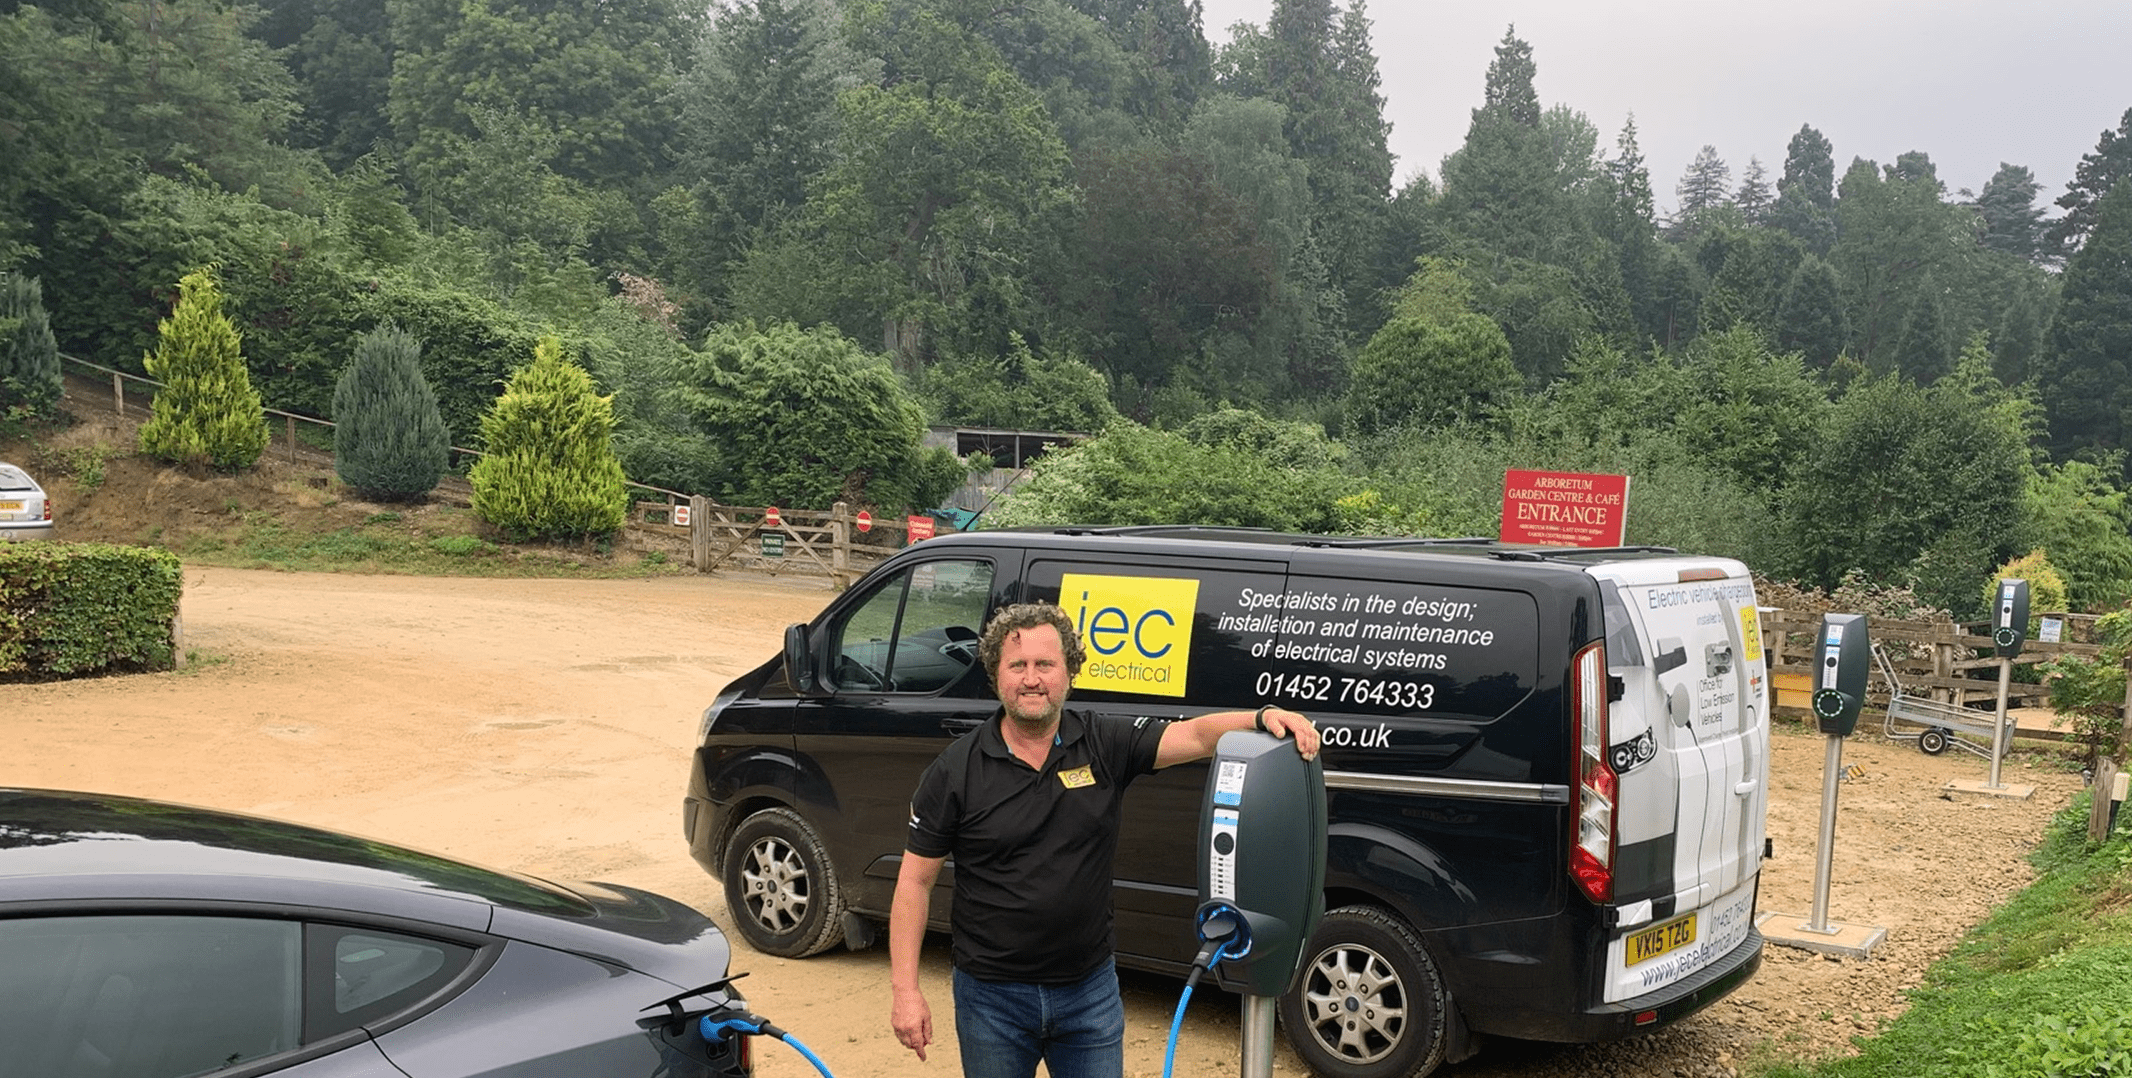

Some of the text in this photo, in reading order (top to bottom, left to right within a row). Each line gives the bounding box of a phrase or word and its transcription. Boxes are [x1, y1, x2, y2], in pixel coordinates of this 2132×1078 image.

[1508, 488, 1546, 500] GARDEN
[1547, 490, 1584, 503] CENTRE
[1585, 493, 1594, 504] &
[1534, 477, 1593, 490] ARBORETUM
[1517, 502, 1607, 525] ENTRANCE
[1239, 588, 1477, 622] Specialists in the design;
[1648, 586, 1688, 609] Electric
[1218, 612, 1493, 646] installation and maintenance
[1251, 639, 1447, 671] of electrical systems
[1088, 660, 1172, 684] electrical
[1256, 672, 1435, 709] 01452 764333
[1636, 920, 1689, 958] VX15 TZG
